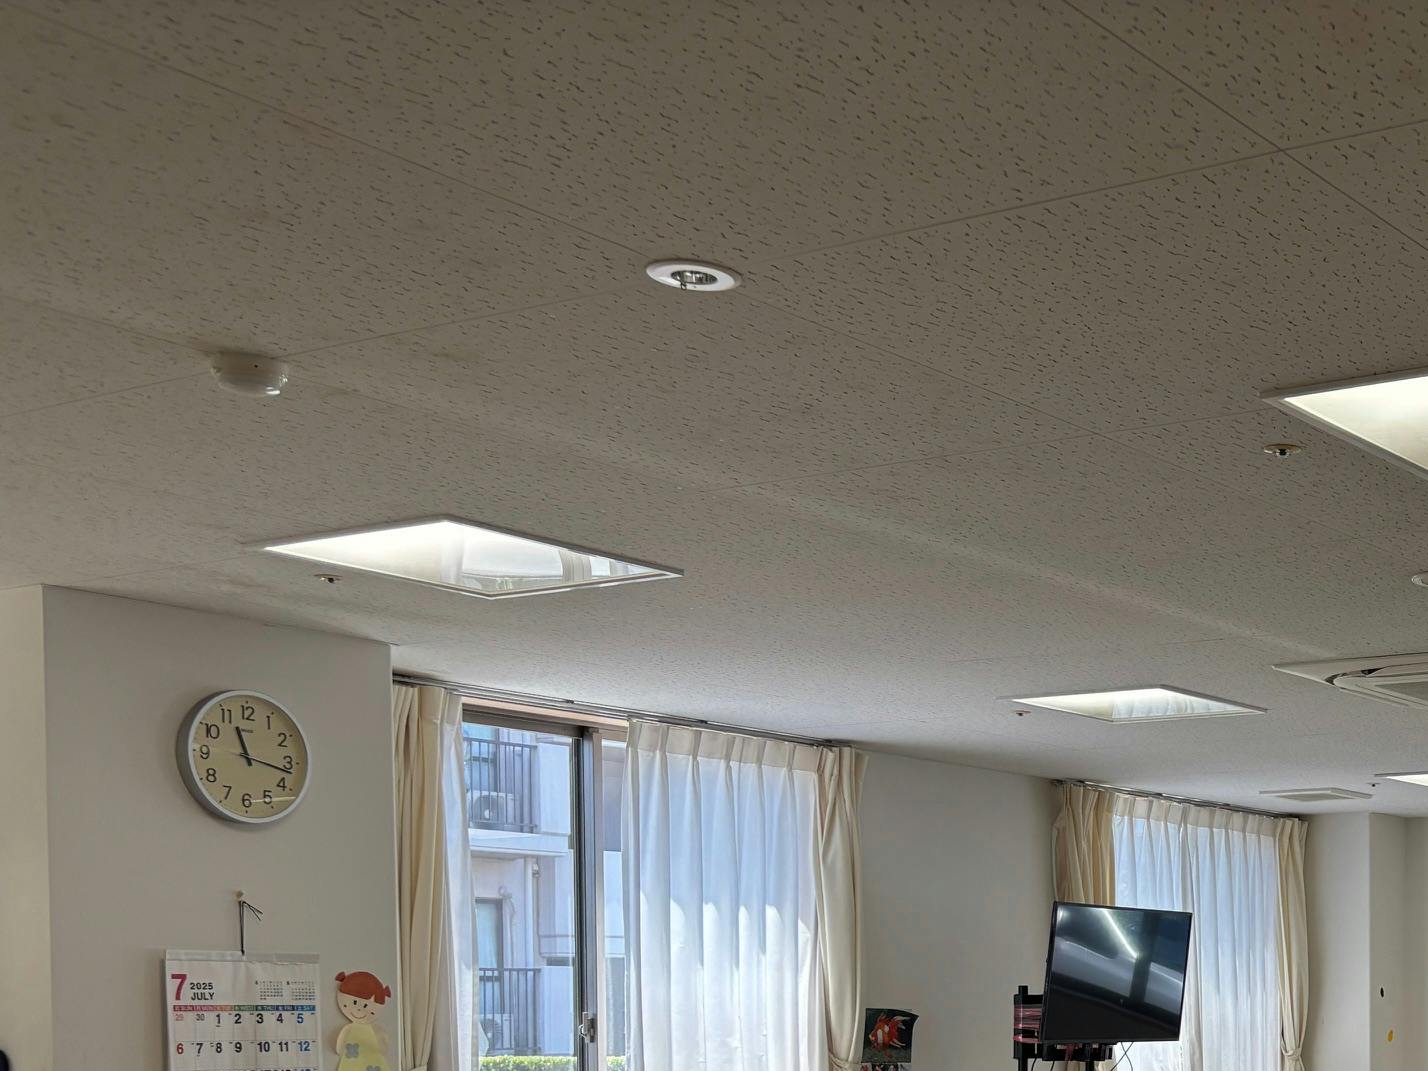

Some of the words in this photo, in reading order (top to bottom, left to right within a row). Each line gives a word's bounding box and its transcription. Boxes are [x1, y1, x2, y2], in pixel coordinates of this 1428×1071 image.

[220, 708, 232, 723] 11
[241, 704, 255, 721] 12
[205, 724, 220, 739] 10
[278, 733, 287, 747] 2
[200, 745, 210, 759] 9
[283, 756, 293, 770] 3
[206, 768, 216, 782] 8
[277, 777, 287, 791] 4
[223, 786, 232, 800] 7
[263, 790, 272, 804] 5
[242, 794, 252, 808] 6
[171, 974, 187, 1000] 7
[190, 982, 213, 990] 2025
[191, 992, 214, 1000] JULY
[234, 1014, 241, 1024] 2
[256, 1014, 263, 1023] 3
[276, 1014, 283, 1023] 4
[297, 1014, 303, 1023] 5
[177, 1043, 184, 1054] 6
[196, 1043, 203, 1053] 7
[216, 1042, 222, 1053] 8
[235, 1042, 242, 1053] 9
[257, 1042, 270, 1052] 10
[278, 1041, 288, 1052] 11
[298, 1041, 310, 1052] 12
